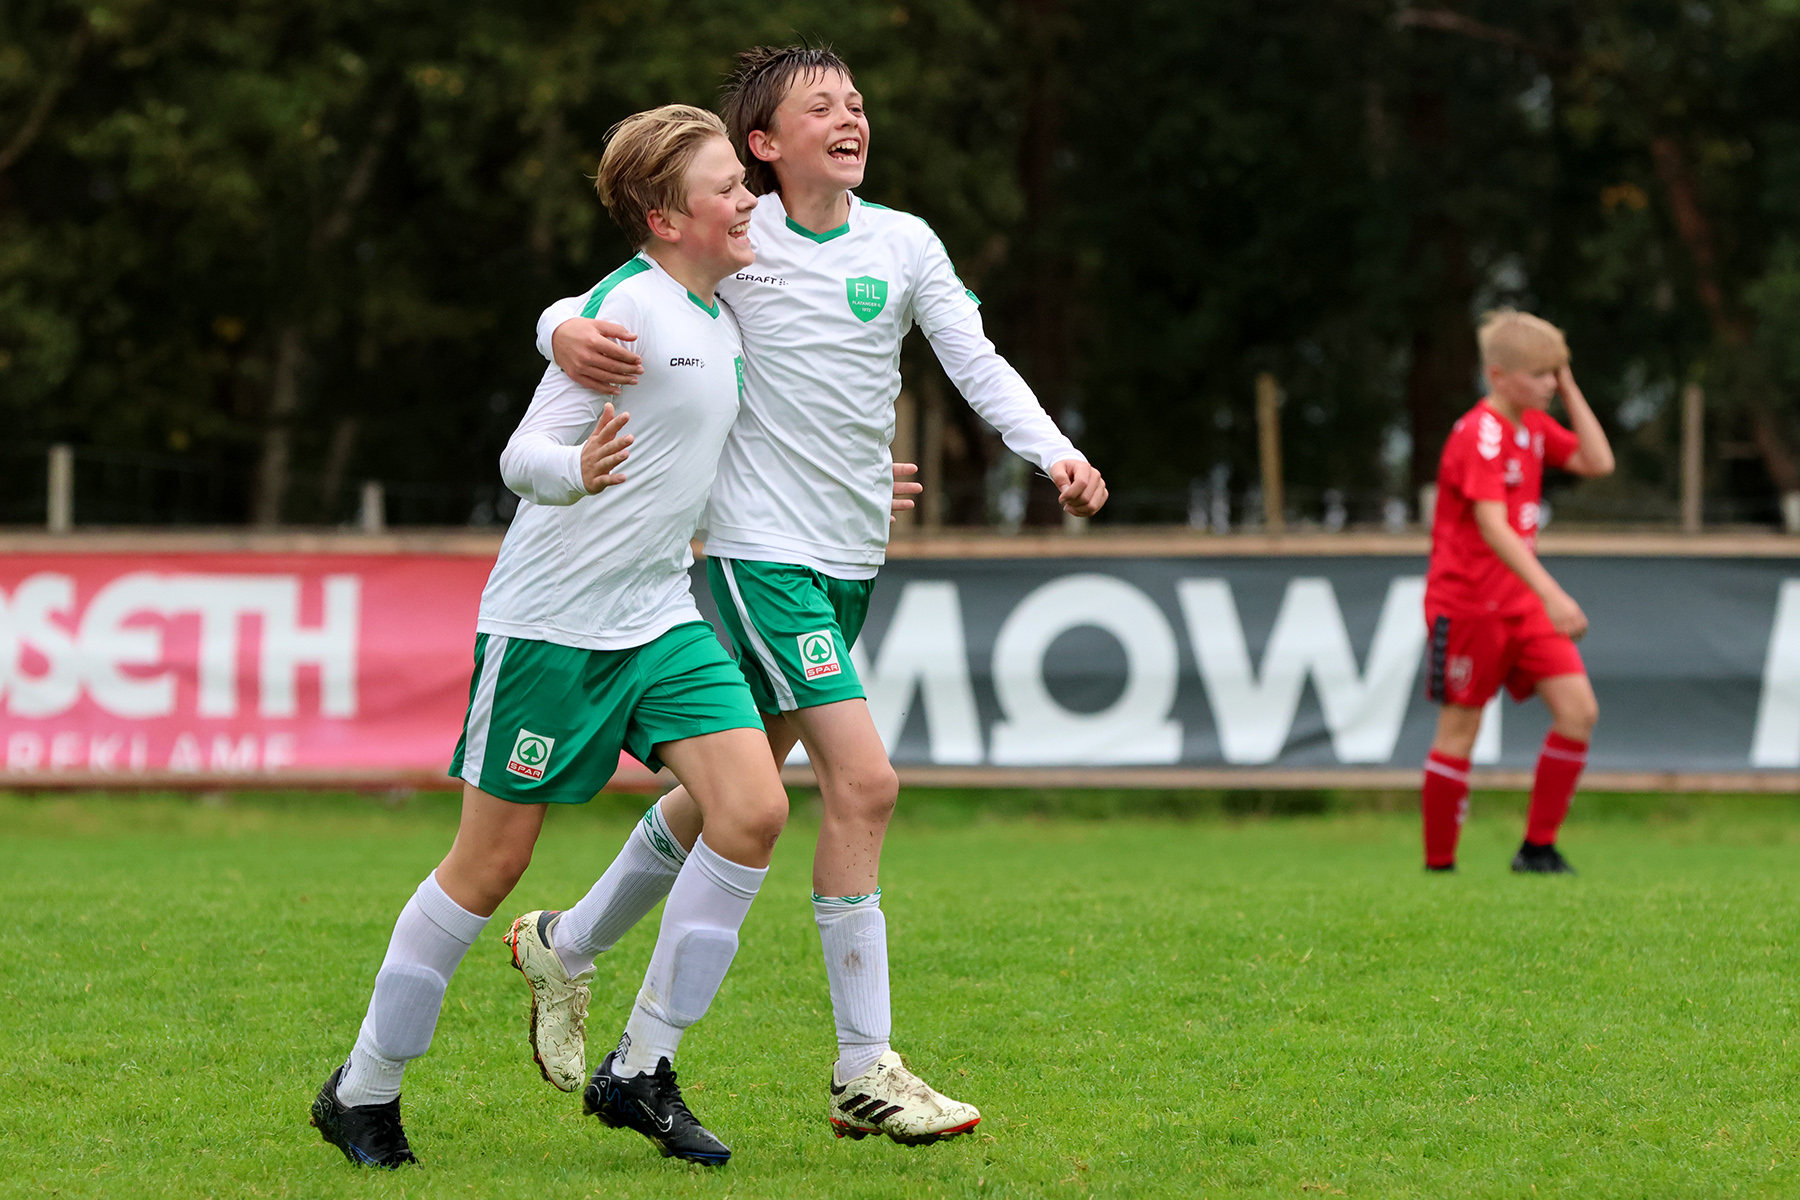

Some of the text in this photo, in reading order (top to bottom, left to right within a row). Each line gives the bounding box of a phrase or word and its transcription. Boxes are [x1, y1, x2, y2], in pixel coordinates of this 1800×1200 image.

[735, 272, 778, 285] CRAFT
[855, 282, 881, 300] FIL
[669, 357, 700, 368] CRAFT
[0, 572, 362, 719] SETH
[807, 664, 839, 676] SPAR
[509, 762, 541, 778] SPAR
